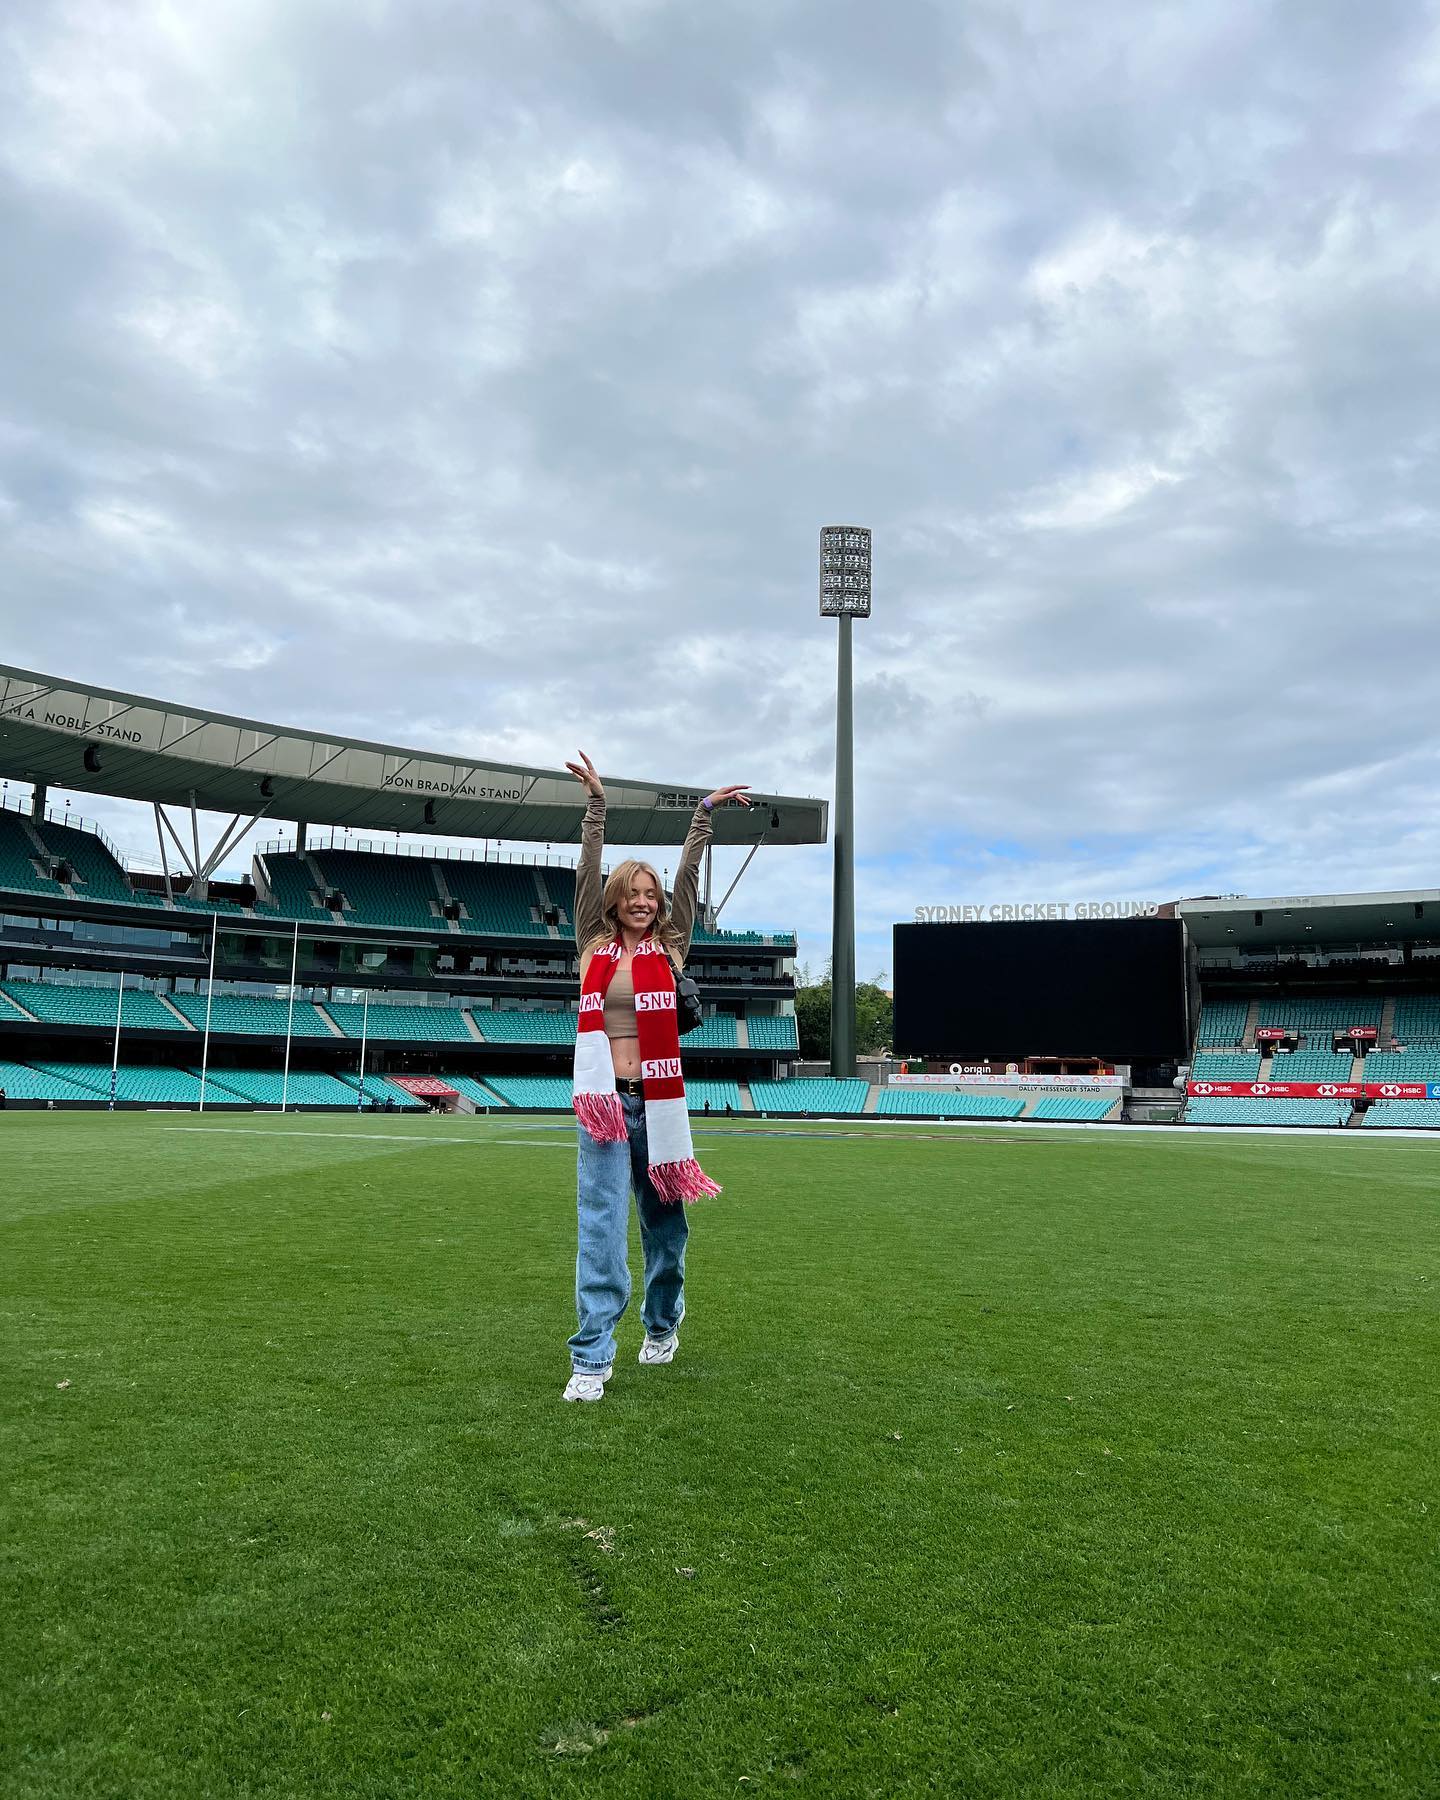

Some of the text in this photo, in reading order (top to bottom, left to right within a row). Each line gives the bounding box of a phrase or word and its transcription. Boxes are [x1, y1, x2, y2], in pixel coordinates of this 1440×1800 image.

[44, 713, 91, 730] NOBLE
[97, 724, 142, 743] STAND
[385, 775, 520, 799] DON BRADMAN STAND
[914, 901, 1159, 920] SYDNEY CRICKET GROUND
[639, 993, 677, 1009] ANS
[963, 1066, 991, 1076] origin
